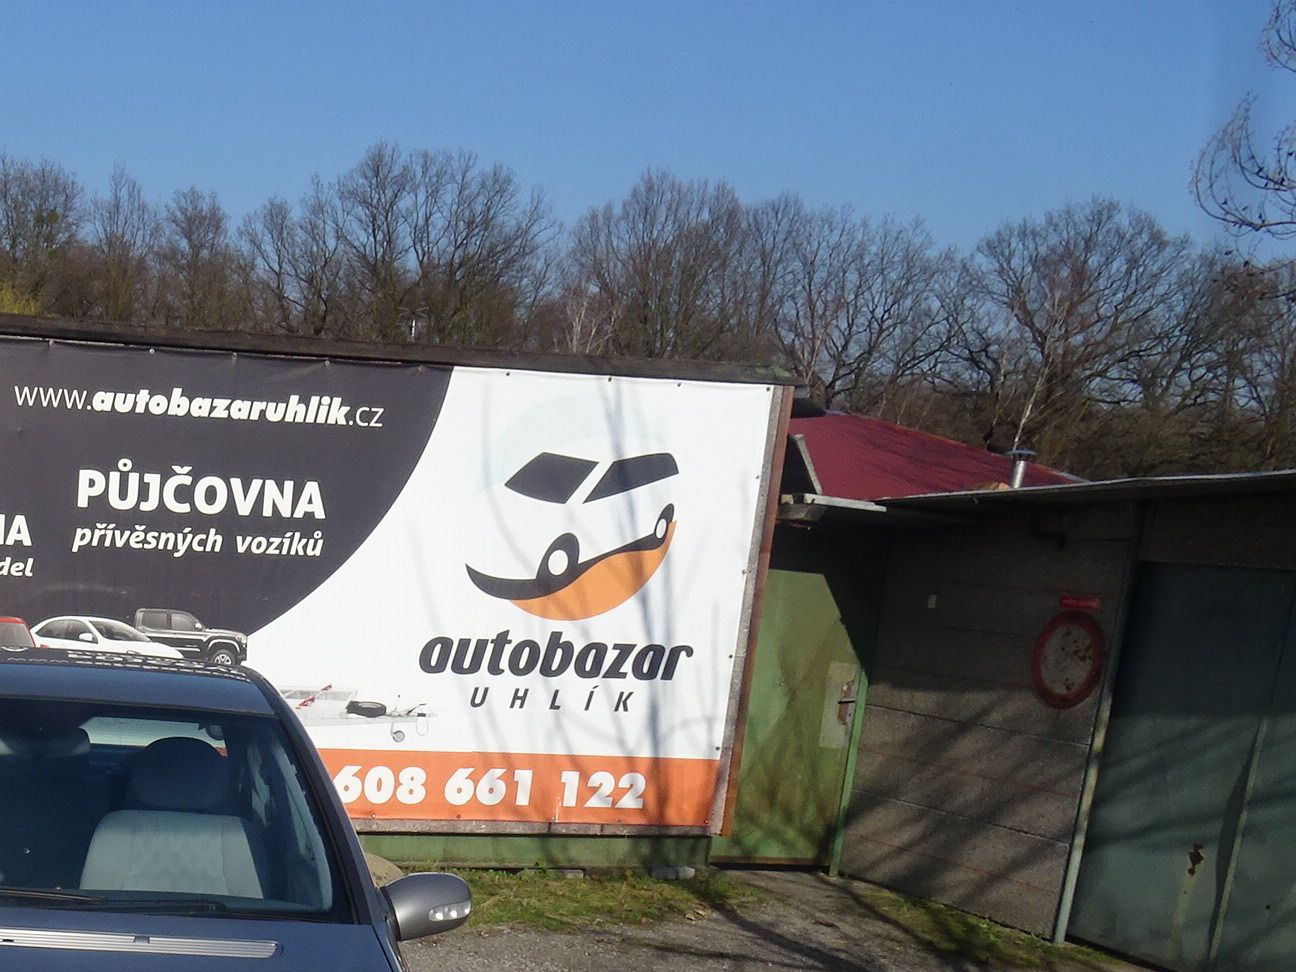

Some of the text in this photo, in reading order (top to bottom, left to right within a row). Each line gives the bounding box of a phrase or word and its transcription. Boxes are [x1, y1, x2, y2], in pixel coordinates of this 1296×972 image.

[14, 386, 384, 428] www.autobazaruhlik.cz
[77, 458, 326, 520] PŮJČOVNA
[71, 522, 324, 558] přívěsných vozíků
[418, 629, 694, 681] autobazar
[470, 685, 634, 712] UHLÍK
[333, 764, 646, 809] 608 661 122
